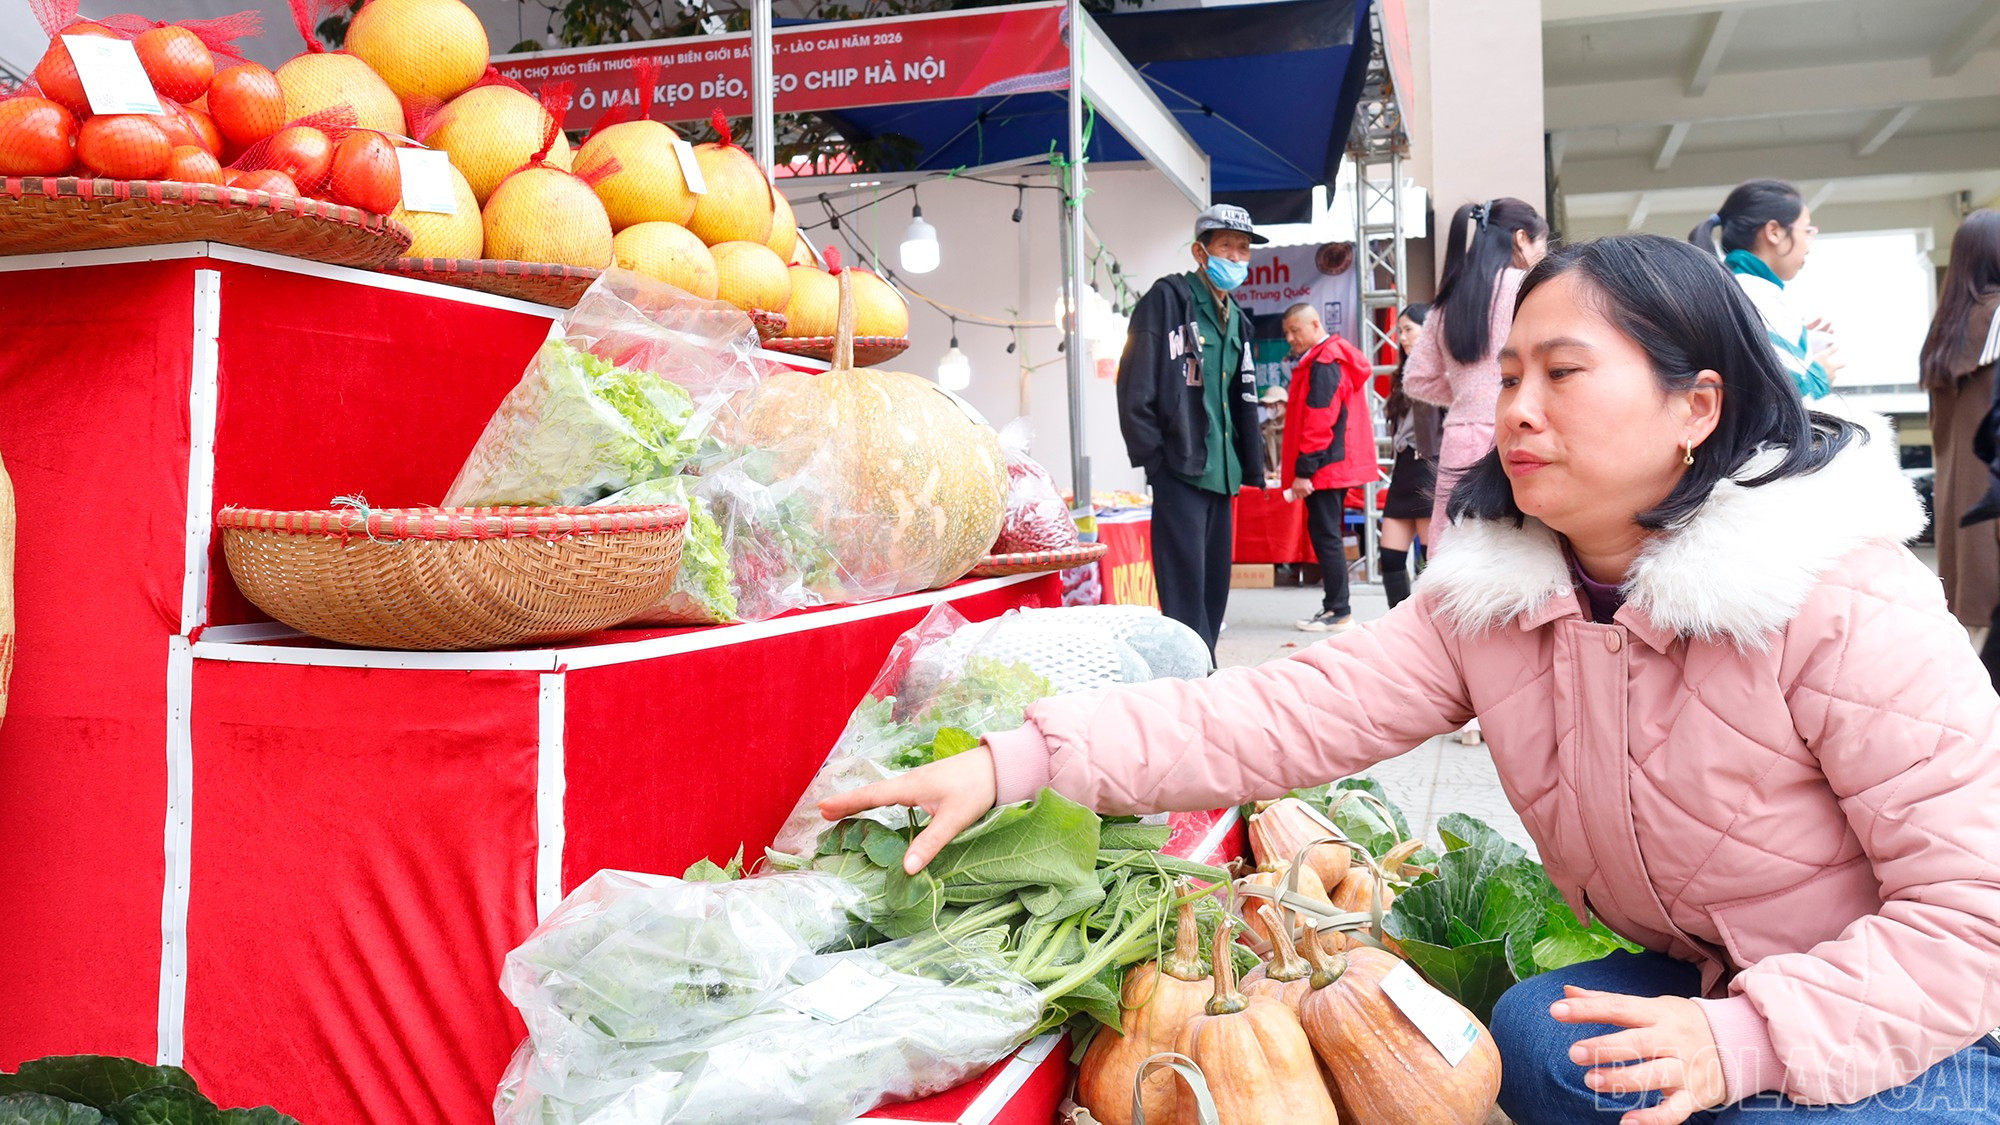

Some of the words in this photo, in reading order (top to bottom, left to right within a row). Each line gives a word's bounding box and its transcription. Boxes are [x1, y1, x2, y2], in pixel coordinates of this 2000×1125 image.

[524, 65, 550, 79] CHỢ
[552, 62, 576, 76] XÚC
[578, 58, 601, 73] TIẾN
[677, 50, 702, 65] BIÊN
[704, 47, 731, 61] GIỚI
[790, 39, 815, 54] LÀO
[817, 38, 839, 51] CAI
[842, 34, 870, 48] NĂM
[873, 32, 903, 45] 2026
[579, 87, 596, 110] Ô
[653, 82, 695, 108] KẸO
[700, 73, 748, 99] DẺO,
[772, 73, 798, 98] ẸO
[804, 67, 858, 90] CHIP
[864, 59, 897, 85] HÀ
[903, 55, 945, 85] NỘI
[1249, 289, 1281, 302] Trung
